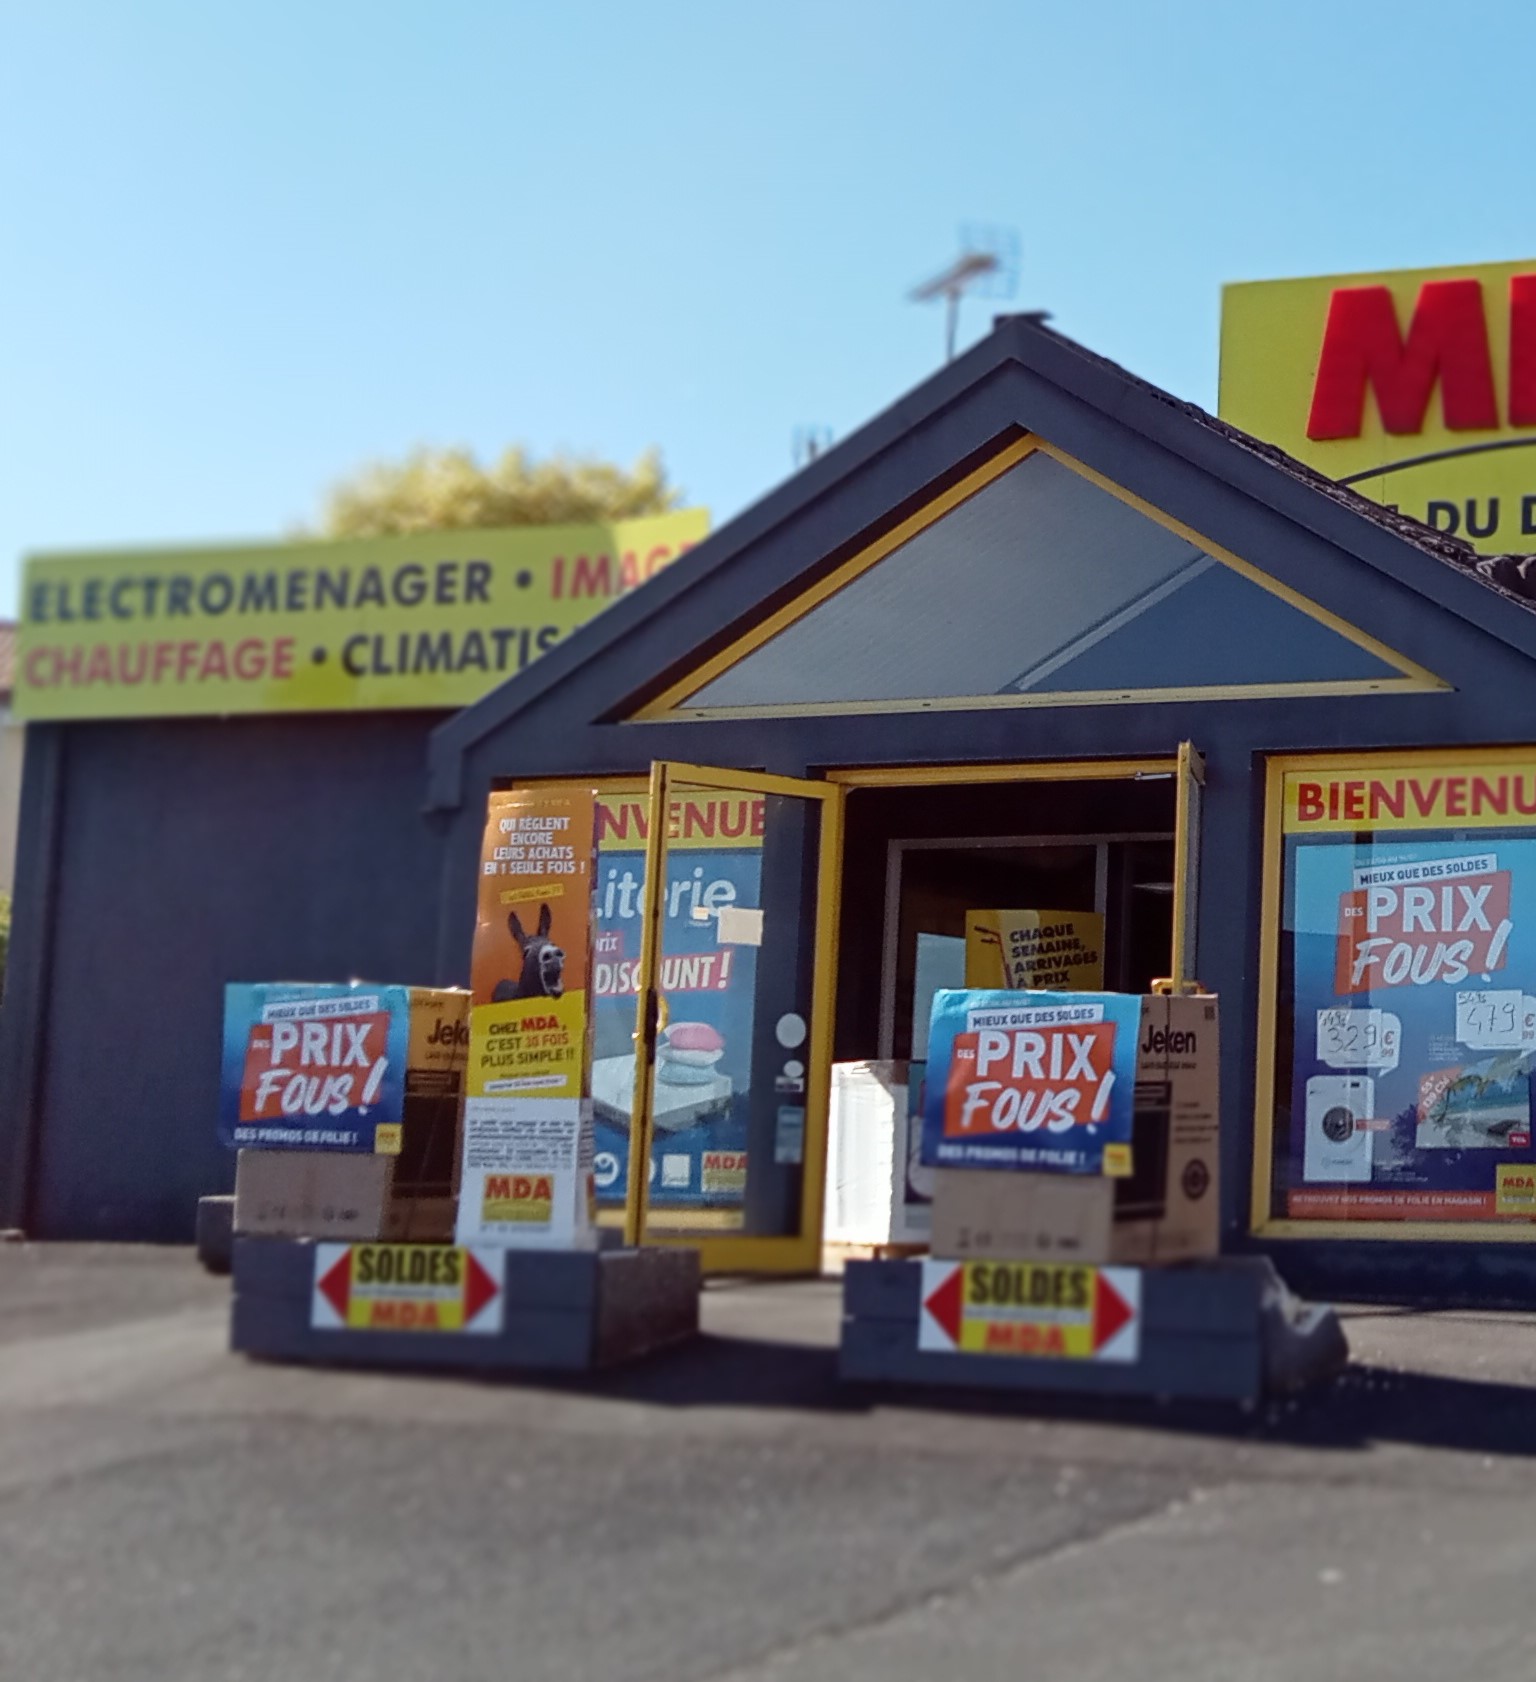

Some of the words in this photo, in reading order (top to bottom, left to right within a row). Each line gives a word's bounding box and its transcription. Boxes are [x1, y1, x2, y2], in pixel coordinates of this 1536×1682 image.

[1427, 497, 1499, 538] DU
[30, 561, 493, 622] ELECTROMENAGER
[551, 540, 697, 600] IMAG
[24, 637, 296, 687] CHAUFFAGE
[341, 625, 582, 677] CLIMATIS
[499, 818, 516, 833] QUI
[511, 832, 553, 845] ENCORE
[494, 847, 524, 860] LEURS
[528, 846, 574, 859] ACHATS
[510, 861, 544, 874] SEULE
[547, 861, 576, 874] FOIS
[1360, 871, 1395, 885] MIEUX
[1397, 868, 1420, 880] QUE
[1422, 865, 1444, 877] DES
[1446, 859, 1488, 874] SOLDES
[1344, 906, 1363, 917] DES
[1367, 885, 1493, 933] PRIX
[1009, 923, 1074, 943] CHAQUE
[1014, 951, 1098, 974] ARRIVAGES
[1032, 970, 1070, 987] PRIX
[489, 1022, 518, 1035] CHEZ
[973, 1014, 1008, 1028] MIEUX
[1009, 1013, 1032, 1024] QUE
[1034, 1011, 1055, 1023] DES
[1057, 1008, 1094, 1021] SOLDES
[271, 1022, 374, 1067] PRIX
[486, 1037, 522, 1053] C'EST
[542, 1032, 569, 1046] FOIS
[1142, 1024, 1197, 1054] Jeken
[1328, 1024, 1377, 1053] 329
[481, 1055, 514, 1068] PLUS
[517, 1049, 563, 1065] SIMPLE
[957, 1049, 975, 1059] DES
[976, 1031, 1098, 1082] PRIX
[485, 1176, 551, 1200] MDA
[1503, 1177, 1535, 1188] MDA
[358, 1247, 459, 1284] SOLDES
[971, 1265, 1088, 1307] SOLDES
